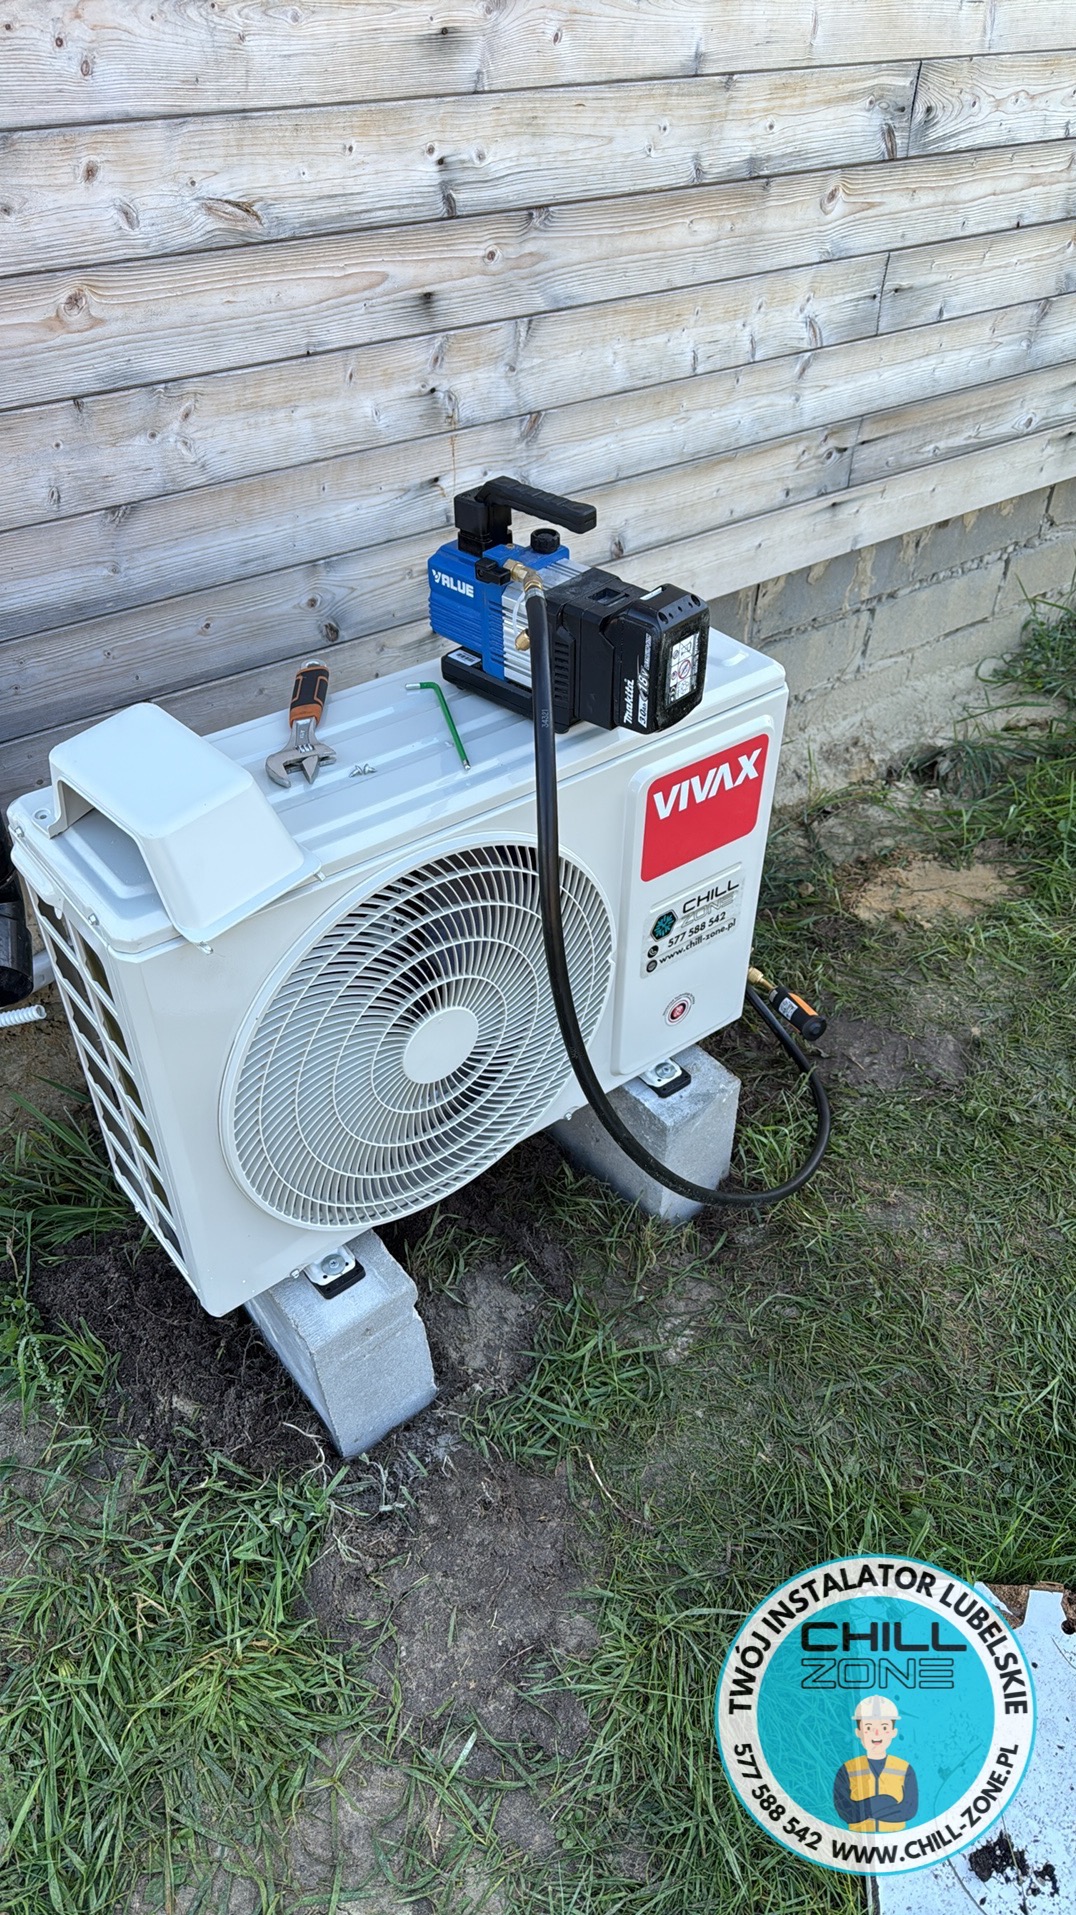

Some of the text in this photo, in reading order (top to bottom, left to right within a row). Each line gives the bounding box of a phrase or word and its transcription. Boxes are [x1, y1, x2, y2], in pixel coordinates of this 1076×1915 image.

[431, 568, 475, 598] VALUE
[623, 679, 634, 724] makita
[653, 748, 762, 820] VIVAX
[681, 893, 734, 928] ZONE
[683, 880, 739, 914] CHILL
[659, 918, 736, 964] www.chill-zone.pl
[668, 911, 726, 948] 577 588 542
